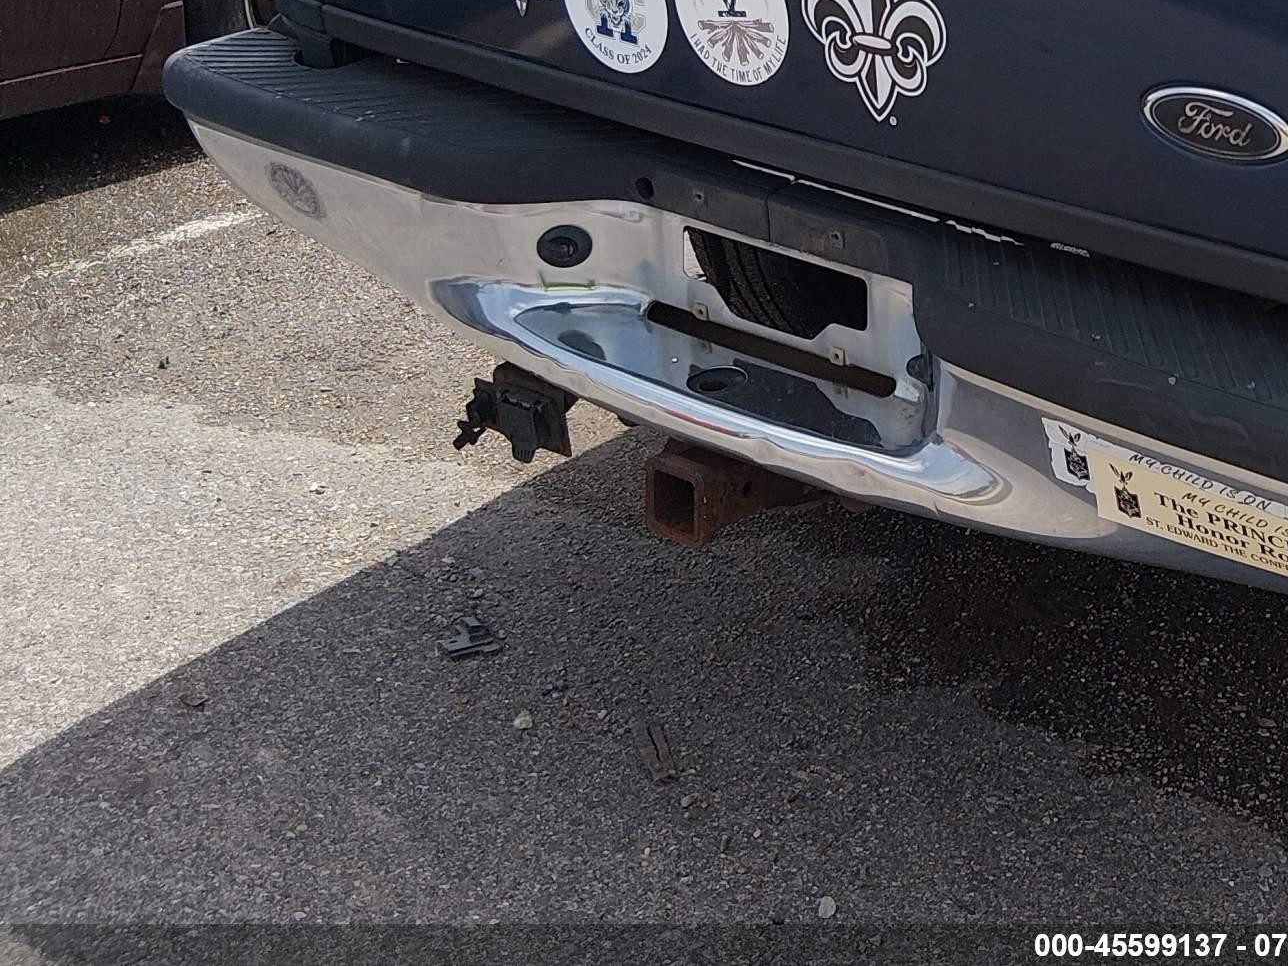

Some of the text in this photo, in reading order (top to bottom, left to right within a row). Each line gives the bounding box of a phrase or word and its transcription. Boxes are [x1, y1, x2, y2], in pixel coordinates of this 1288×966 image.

[585, 27, 652, 65] CLASS OF 2024
[694, 40, 710, 60] HAD
[711, 57, 728, 76] THE
[730, 68, 752, 83] TIME
[753, 67, 762, 81] OF
[763, 59, 776, 75] MY
[774, 35, 787, 62] LIFE
[1178, 101, 1252, 147] Ford
[1129, 454, 1272, 512] MY CHILD IS ON
[1154, 492, 1199, 518] The
[1182, 492, 1210, 507] MY
[1214, 504, 1268, 528] CHILD
[1146, 517, 1163, 530] ST.
[1167, 524, 1218, 548] EDWARD
[1221, 543, 1248, 558] THE
[1176, 514, 1250, 549] Honor
